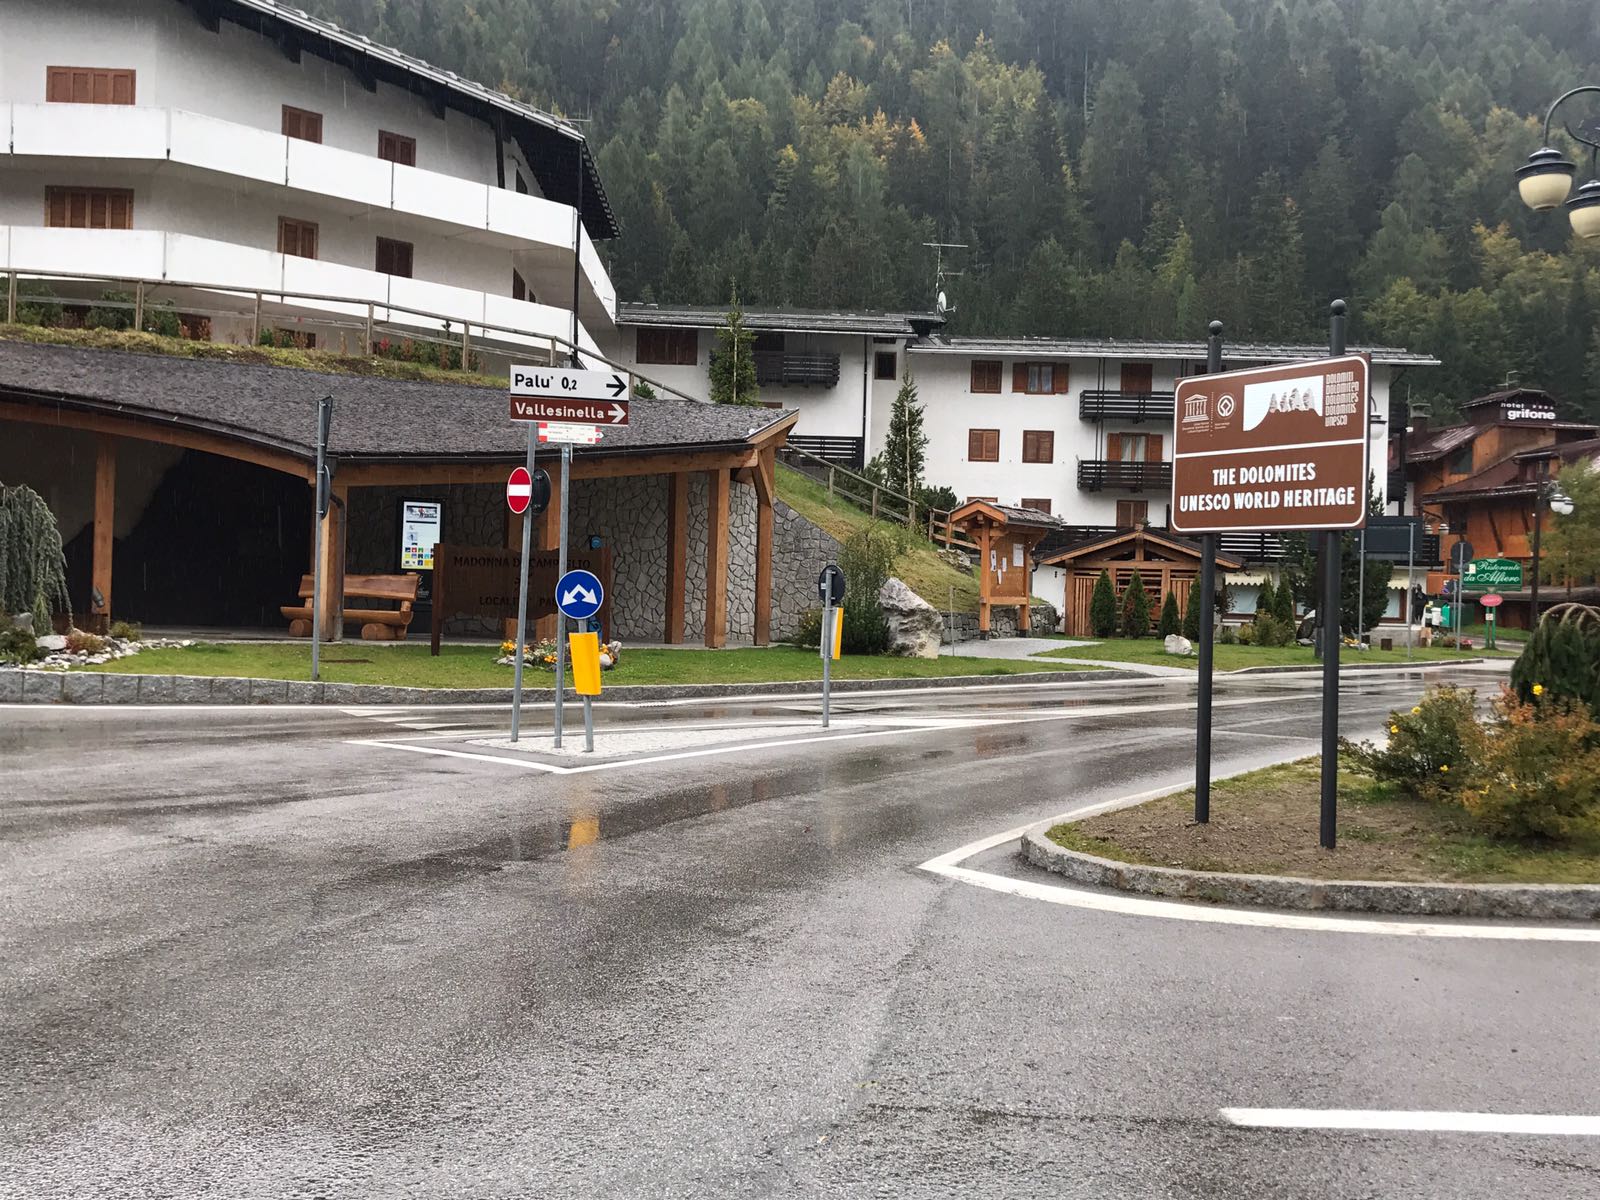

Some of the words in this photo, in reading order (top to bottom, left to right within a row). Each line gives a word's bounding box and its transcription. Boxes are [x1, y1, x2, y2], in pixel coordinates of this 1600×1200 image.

[515, 373, 554, 389] Palu'
[561, 376, 577, 391] 0,2
[515, 402, 604, 419] Vallesinella
[1507, 409, 1556, 420] grifone
[1212, 469, 1236, 486] THE
[1239, 462, 1316, 485] DOLOMITES
[1179, 493, 1230, 512] UNESCO
[1233, 491, 1280, 509] WORLD
[1283, 486, 1356, 508] HERITAGE
[453, 555, 510, 568] MADONNA
[1476, 560, 1521, 571] Ristorante
[1463, 573, 1476, 582] da
[1476, 571, 1520, 585] Alfiero
